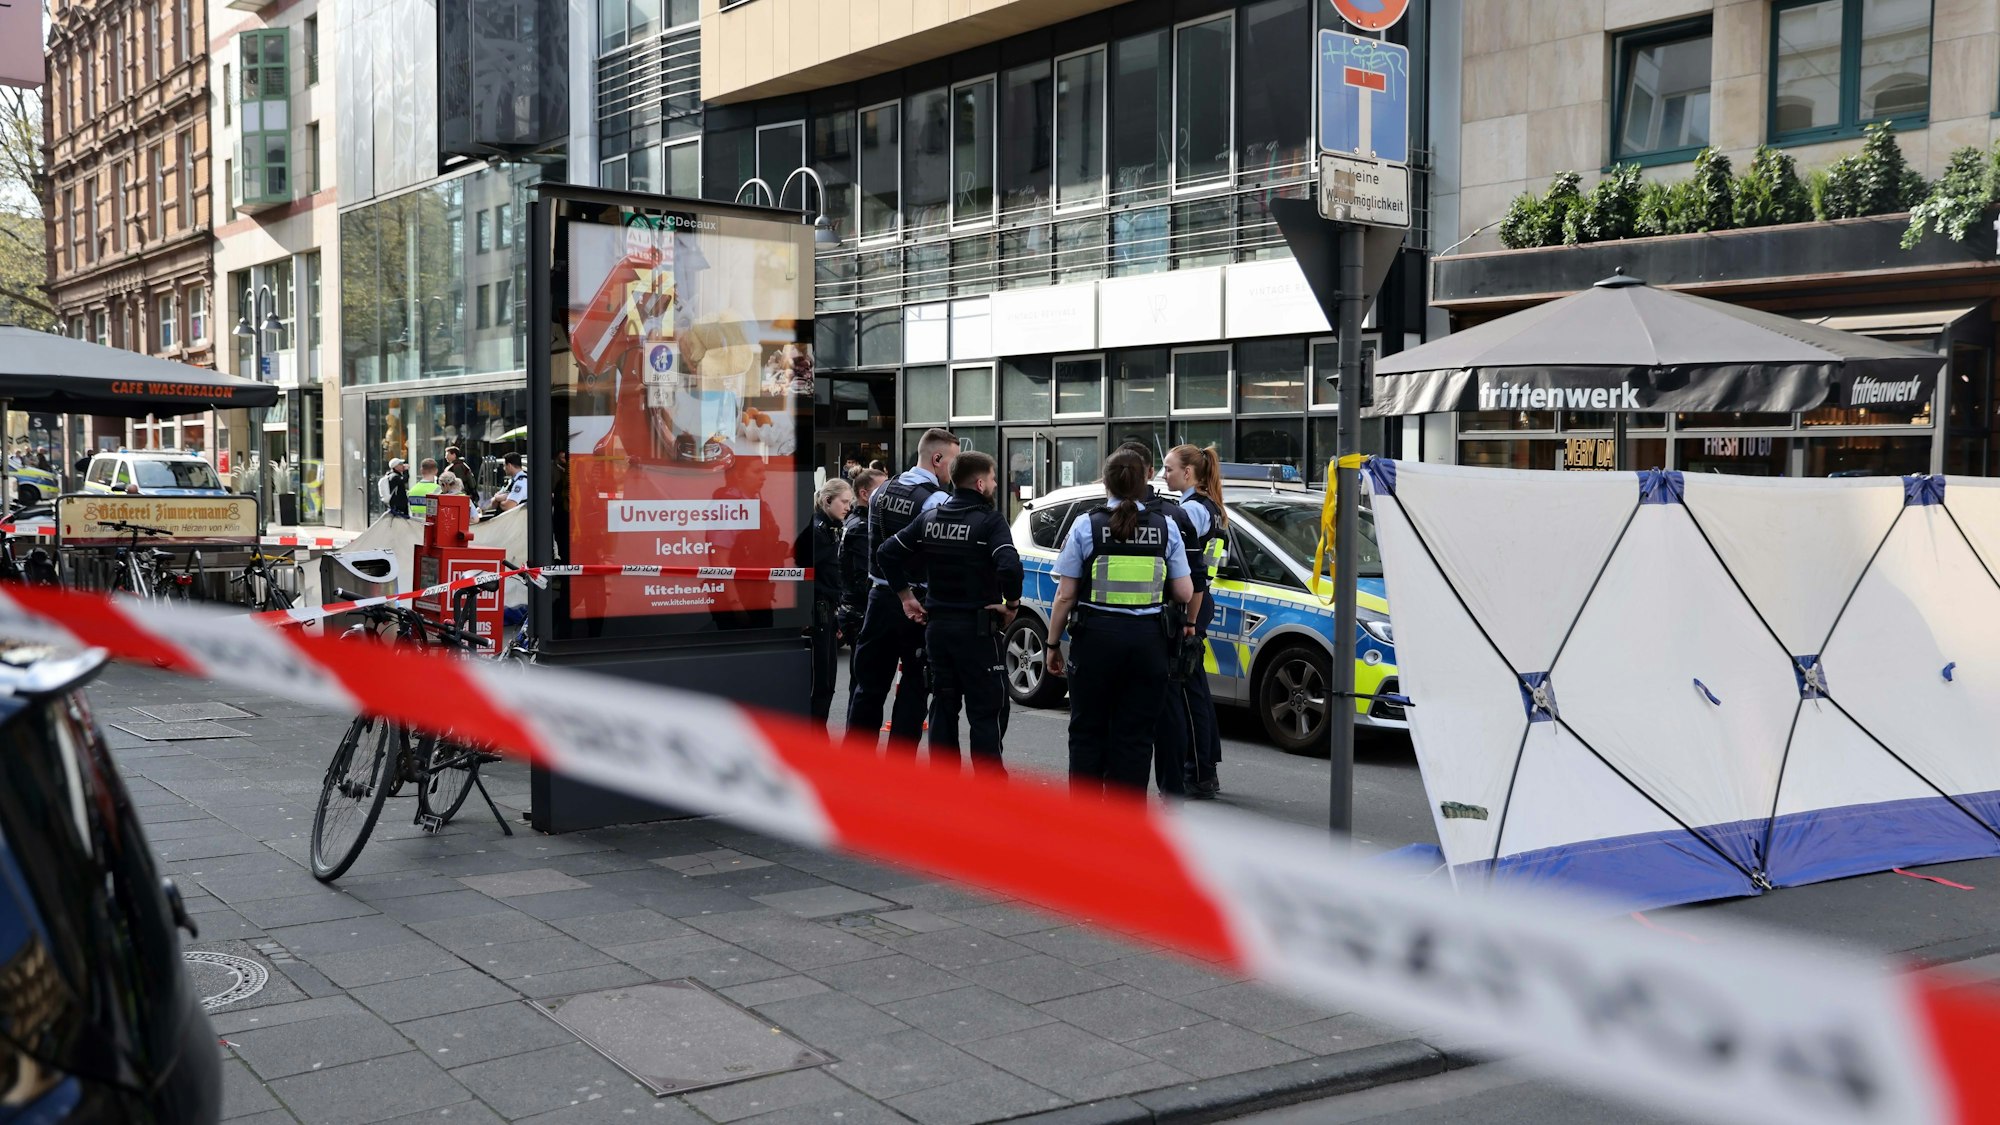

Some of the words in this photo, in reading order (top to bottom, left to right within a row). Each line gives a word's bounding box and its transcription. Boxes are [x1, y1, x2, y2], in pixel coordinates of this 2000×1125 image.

[1348, 167, 1380, 185] eine
[1325, 187, 1404, 213] Wmöglichkeit
[661, 215, 717, 231] JCDecaux
[1248, 284, 1291, 298] VINTAGE
[111, 381, 144, 395] CAFE
[148, 383, 234, 398] WASCHSALON
[1479, 381, 1641, 409] frittenwerk
[1851, 374, 1922, 406] frittenwerk
[155, 502, 230, 523] Zimmermann
[875, 493, 915, 516] POLIZEI
[620, 504, 749, 526] Unvergesslich
[924, 522, 971, 541] POLIZEI
[655, 537, 716, 555] lecker.
[698, 567, 734, 576] POLIZEI
[770, 568, 803, 578] POLIZEI
[644, 583, 725, 596] KitchenAid
[651, 597, 715, 607] www.kitchenaid.de
